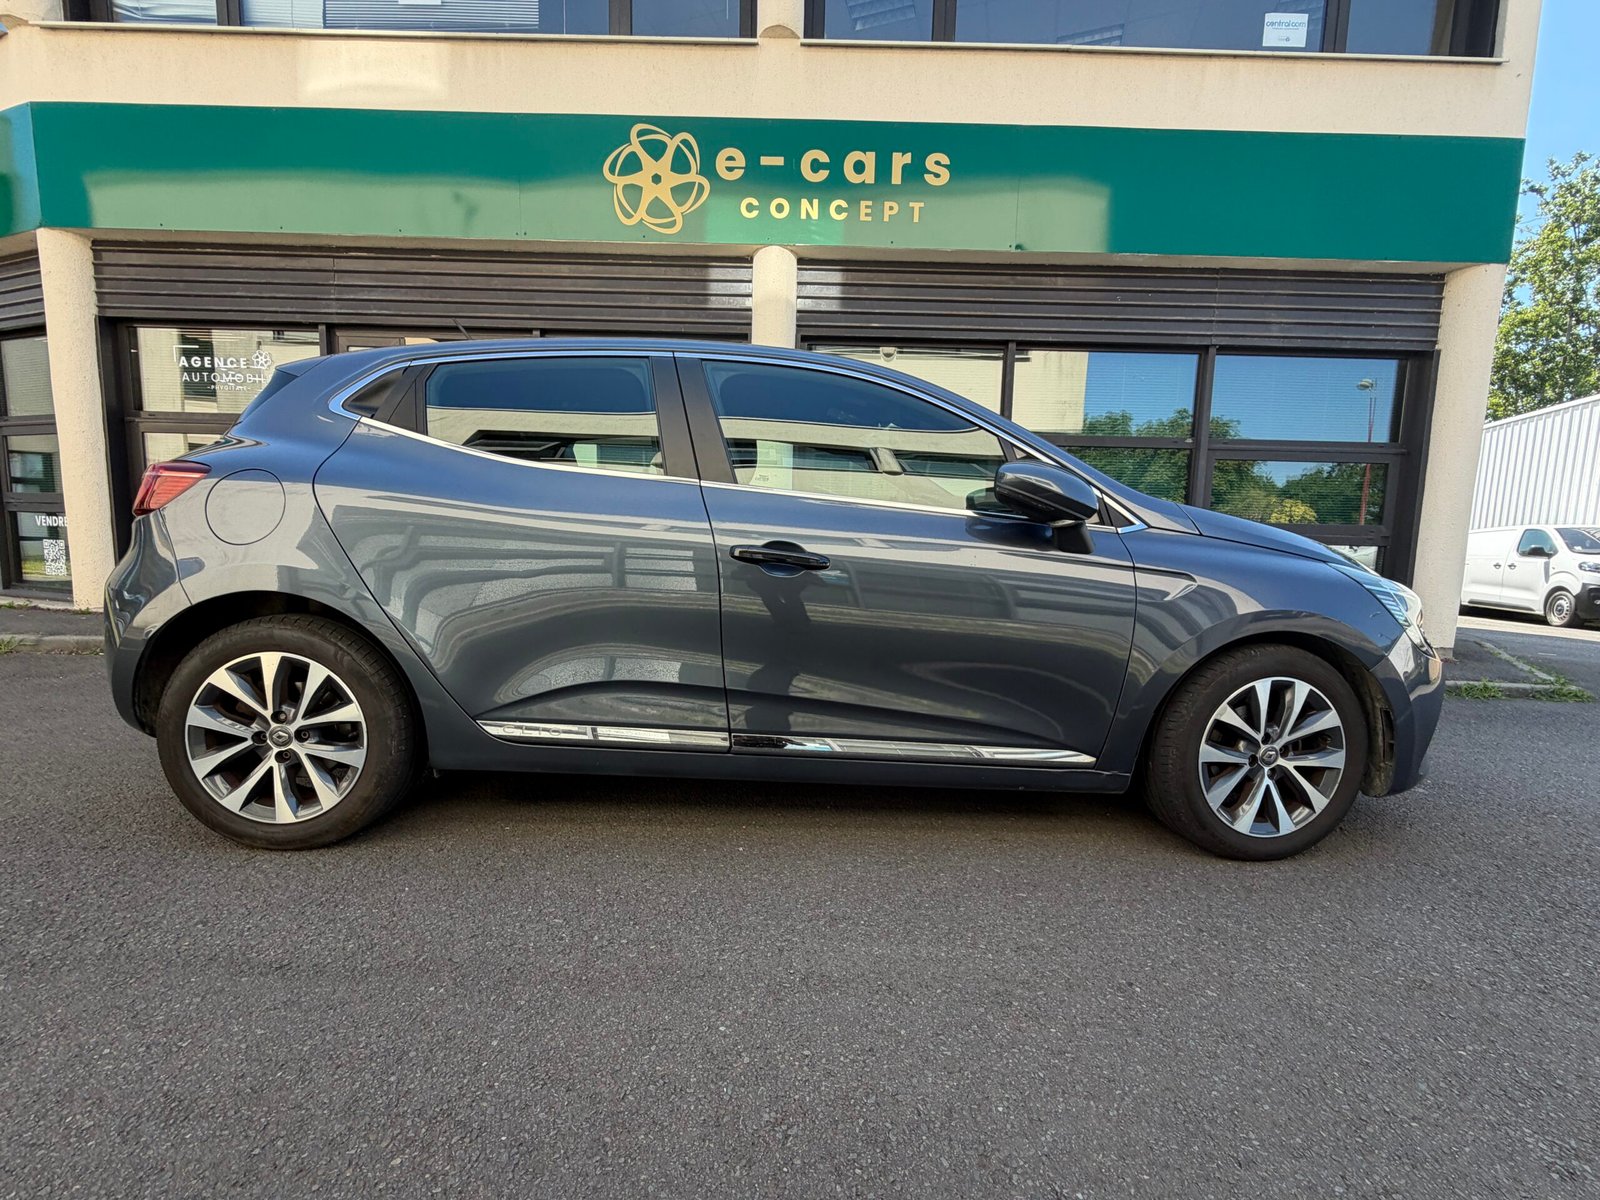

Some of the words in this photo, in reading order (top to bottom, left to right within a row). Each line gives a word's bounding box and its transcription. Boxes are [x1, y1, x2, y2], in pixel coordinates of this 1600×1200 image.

[715, 147, 951, 186] e-cars
[740, 197, 925, 223] CONCEPT
[179, 356, 248, 368] AGENCE
[35, 515, 68, 526] VENDRE
[502, 724, 562, 736] CLIO
